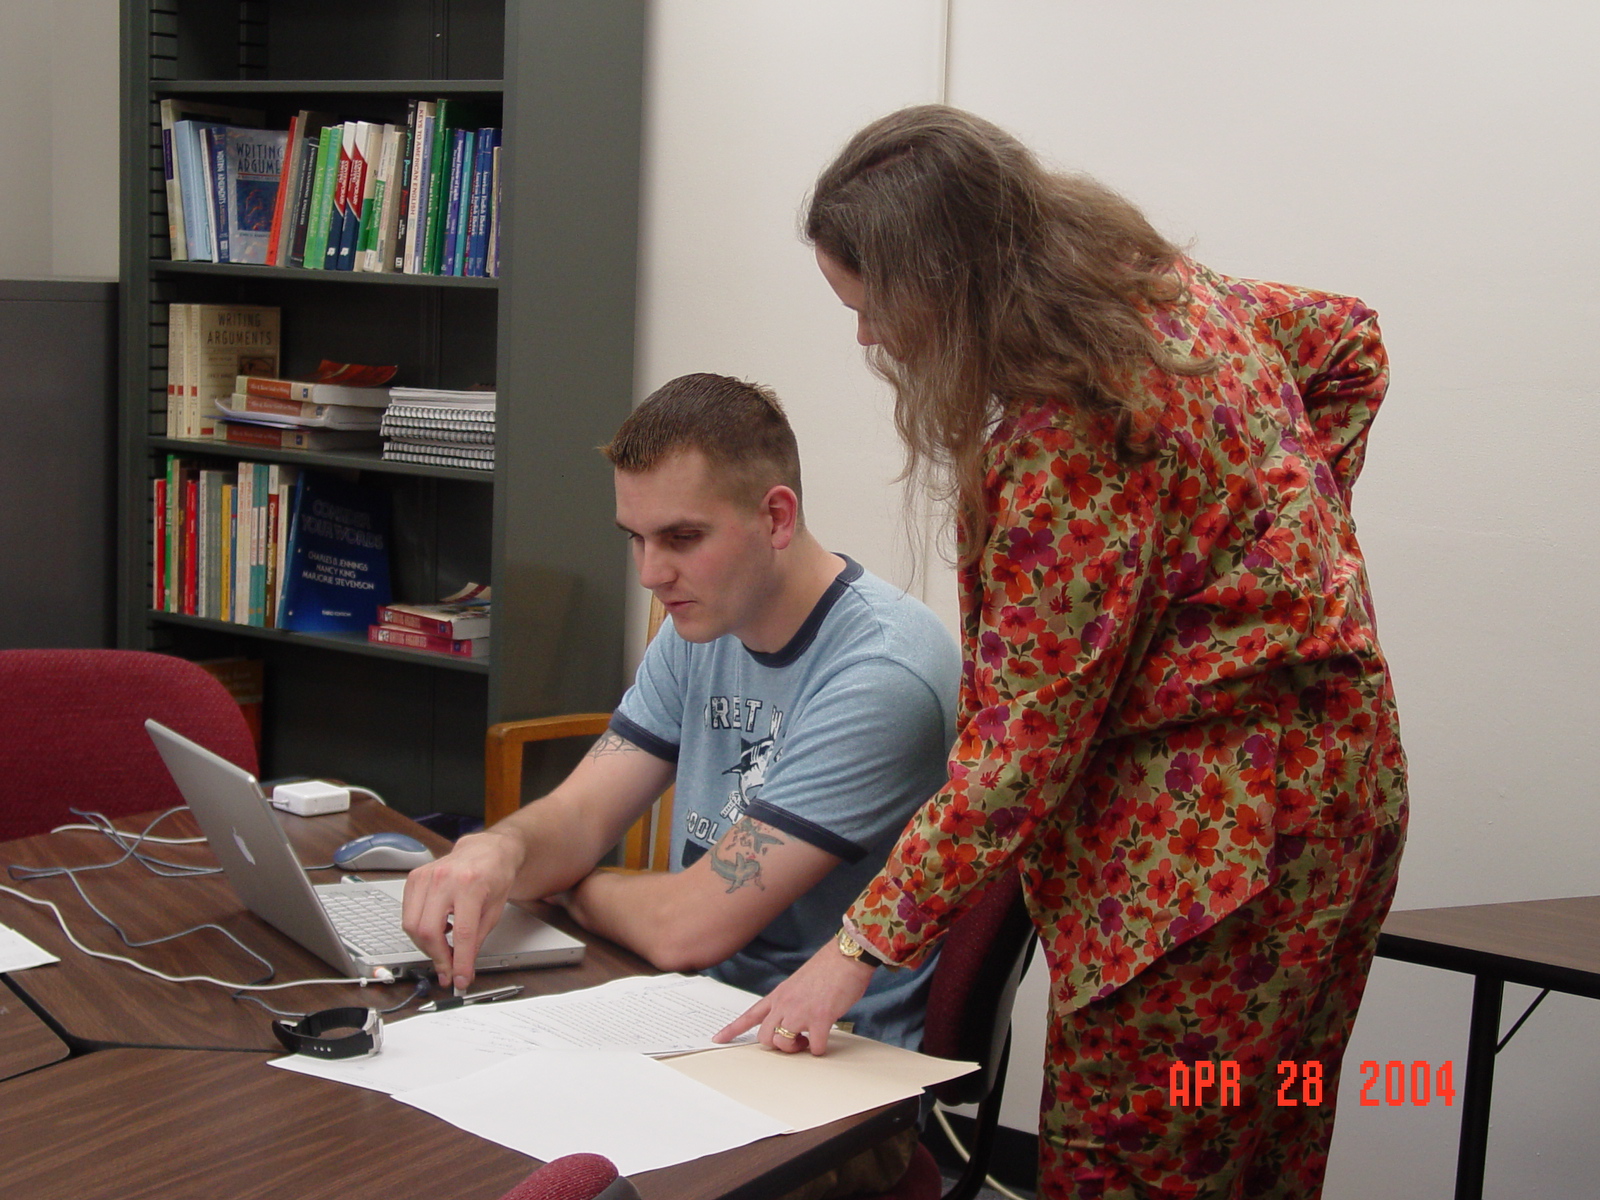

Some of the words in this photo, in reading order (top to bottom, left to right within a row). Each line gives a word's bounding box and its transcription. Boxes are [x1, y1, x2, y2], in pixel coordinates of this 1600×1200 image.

[416, 130, 422, 139] TO
[215, 149, 225, 172] WRITING
[303, 146, 315, 197] UNDERSTANDING
[412, 140, 421, 181] AMERICAN
[216, 172, 226, 204] ARGUMENTS
[338, 160, 349, 204] CONTEMPORARY
[352, 160, 363, 204] CONTEMPORARY
[299, 198, 307, 225] ENGLISH
[409, 182, 417, 215] ENGLISH
[218, 312, 261, 328] WRITING
[207, 331, 272, 346] ARGUMENTS
[267, 502, 275, 548] Contemporary
[301, 514, 334, 539] YOUR
[335, 525, 384, 550] WORDS
[265, 549, 273, 584] Vocabulary
[308, 551, 332, 565] CHARLES
[339, 556, 368, 572] JENNINGS
[316, 564, 338, 575] NANCY
[339, 568, 356, 579] KING
[302, 570, 333, 585] MARJORIE
[335, 576, 375, 590] STEVENSON
